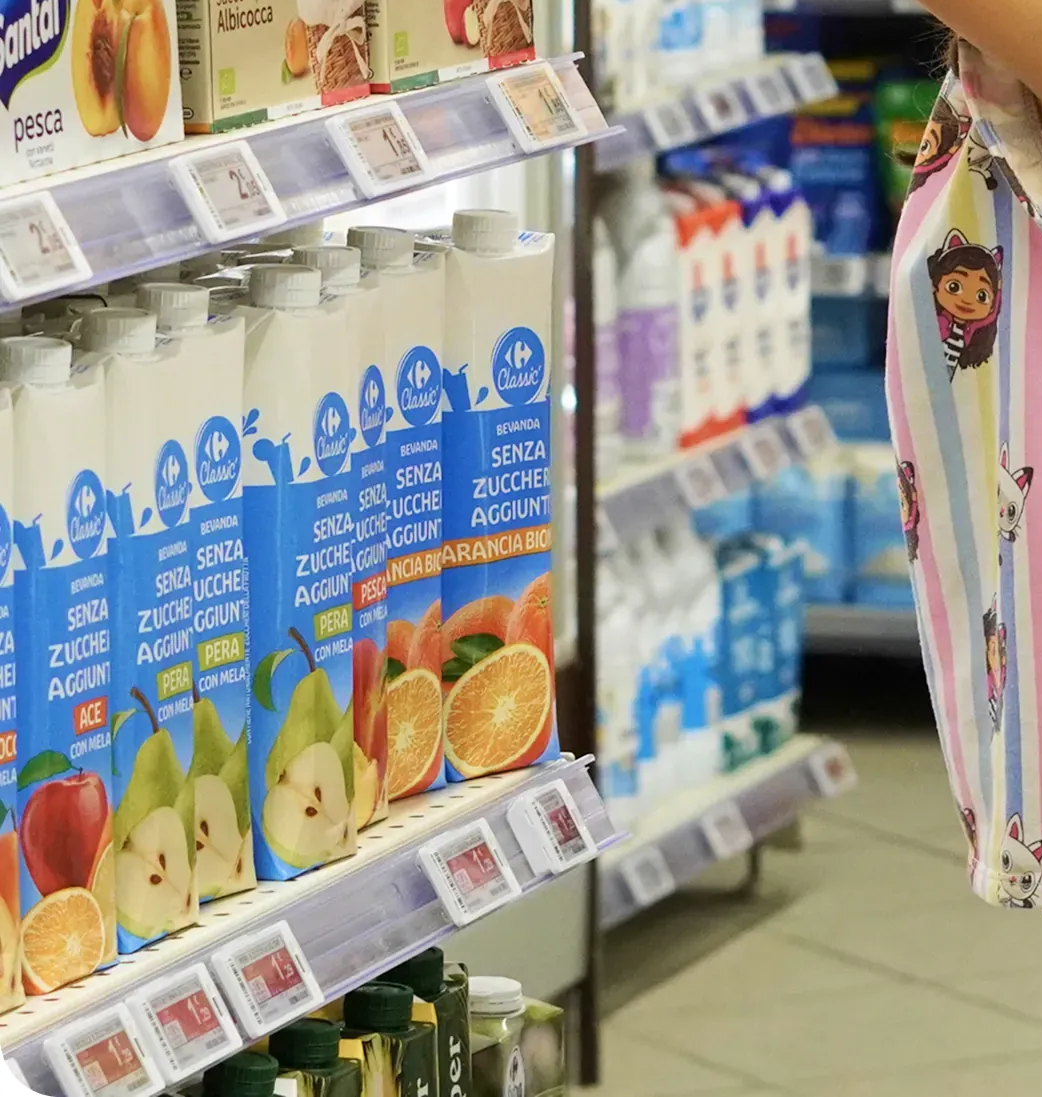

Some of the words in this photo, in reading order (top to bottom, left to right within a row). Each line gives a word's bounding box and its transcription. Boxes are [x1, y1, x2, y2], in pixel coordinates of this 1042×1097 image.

[217, 5, 274, 34] Albicocca
[14, 108, 64, 153] pesca
[496, 418, 541, 436] BEVANDA
[401, 439, 438, 457] BEVANDA
[491, 439, 546, 468] SENZA
[361, 458, 384, 479] BEVANDA
[396, 461, 442, 489] SENZA
[472, 466, 550, 499] ZUCCHER
[316, 489, 348, 509] BEVANDA
[359, 482, 387, 512] SENZA
[386, 490, 442, 520] UCCHE
[200, 514, 239, 536] BEVANDA
[313, 511, 352, 544] SENZA
[158, 540, 187, 562] BEVANDA
[196, 539, 243, 571] SENZA
[296, 543, 353, 577] ZUCCHE
[442, 531, 523, 565] ARANCIA
[71, 572, 104, 595] BEVANDA
[155, 564, 191, 598] SENZA
[194, 569, 242, 602] UCCHE
[361, 576, 387, 604] PESCA
[67, 597, 109, 631] SENZA
[320, 608, 349, 636] PERA
[360, 612, 373, 628] CON
[373, 608, 387, 626] MELA
[204, 637, 240, 666] PERA
[314, 642, 333, 662] CON
[333, 637, 353, 657] MELA
[163, 666, 190, 692] PERA
[198, 672, 219, 693] CON
[220, 665, 246, 688] MELA
[79, 701, 102, 729] ACE
[157, 701, 175, 723] CON
[175, 695, 194, 717] MELA
[70, 736, 89, 760] CON
[88, 730, 111, 754] MELA
